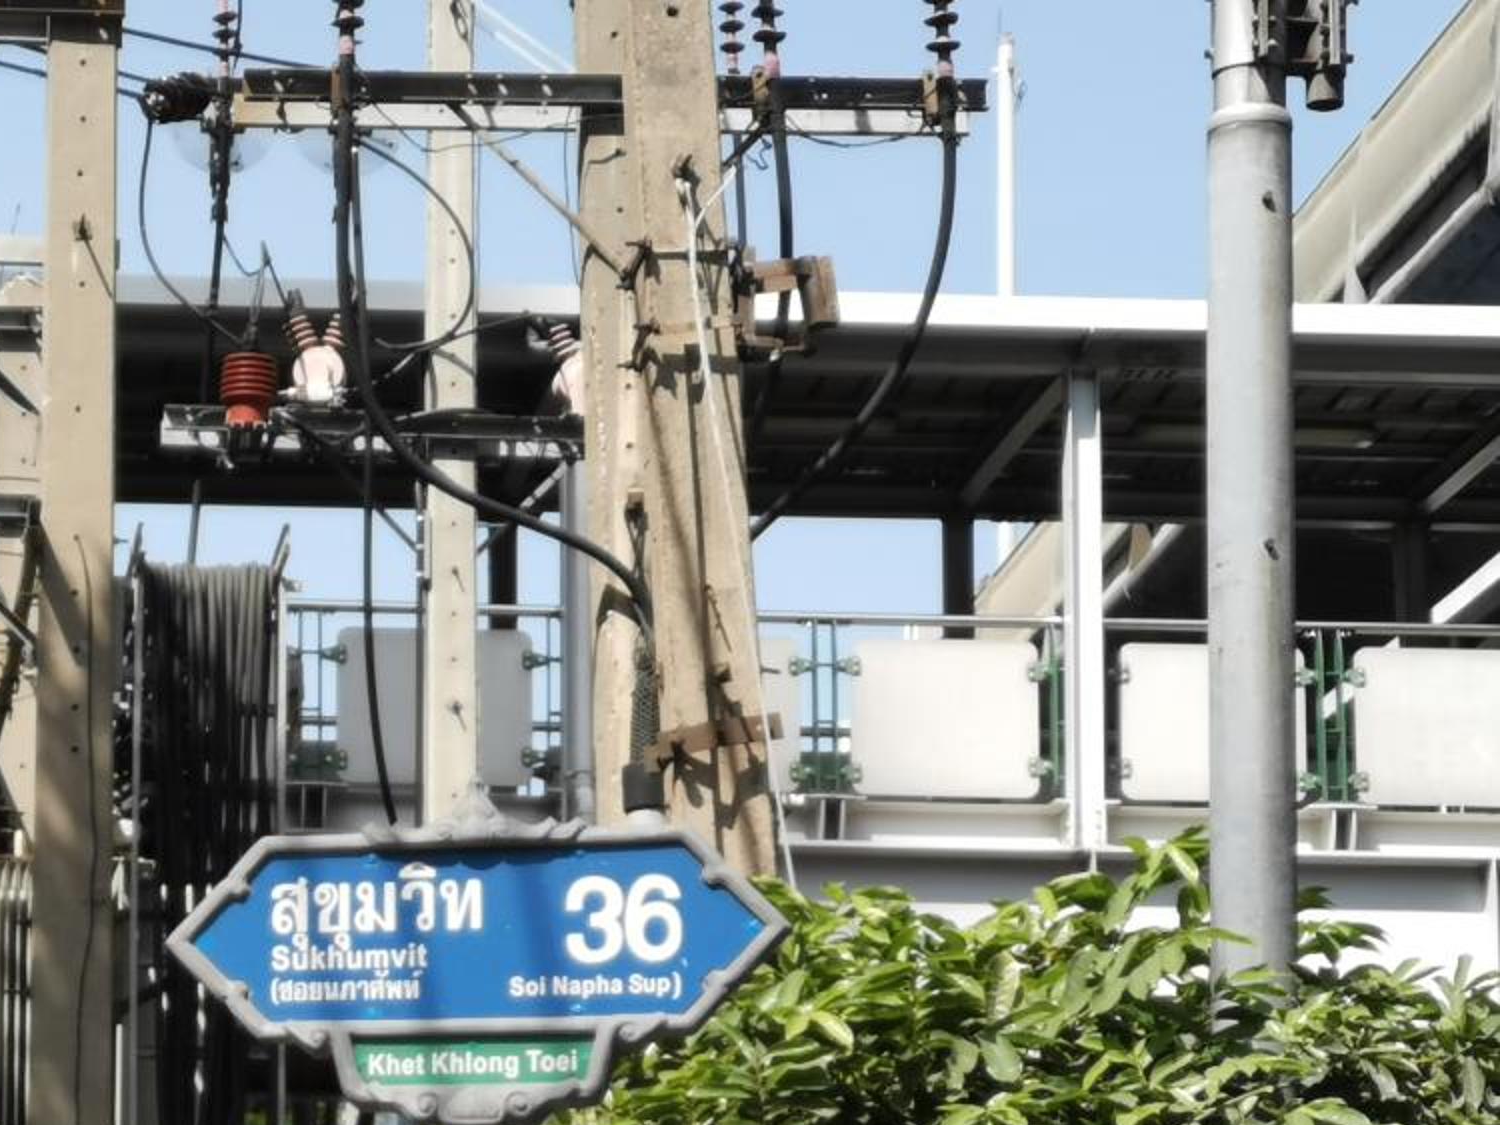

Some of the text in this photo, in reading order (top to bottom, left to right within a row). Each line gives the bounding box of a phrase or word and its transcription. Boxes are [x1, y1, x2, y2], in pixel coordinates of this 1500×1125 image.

[270, 862, 484, 949] สุขุมวิท
[565, 872, 683, 964] 36
[271, 943, 428, 972] Sukhumvit
[509, 971, 683, 1000] Soi Napha Sup)
[367, 1049, 579, 1079] Khet Khlong Toei
